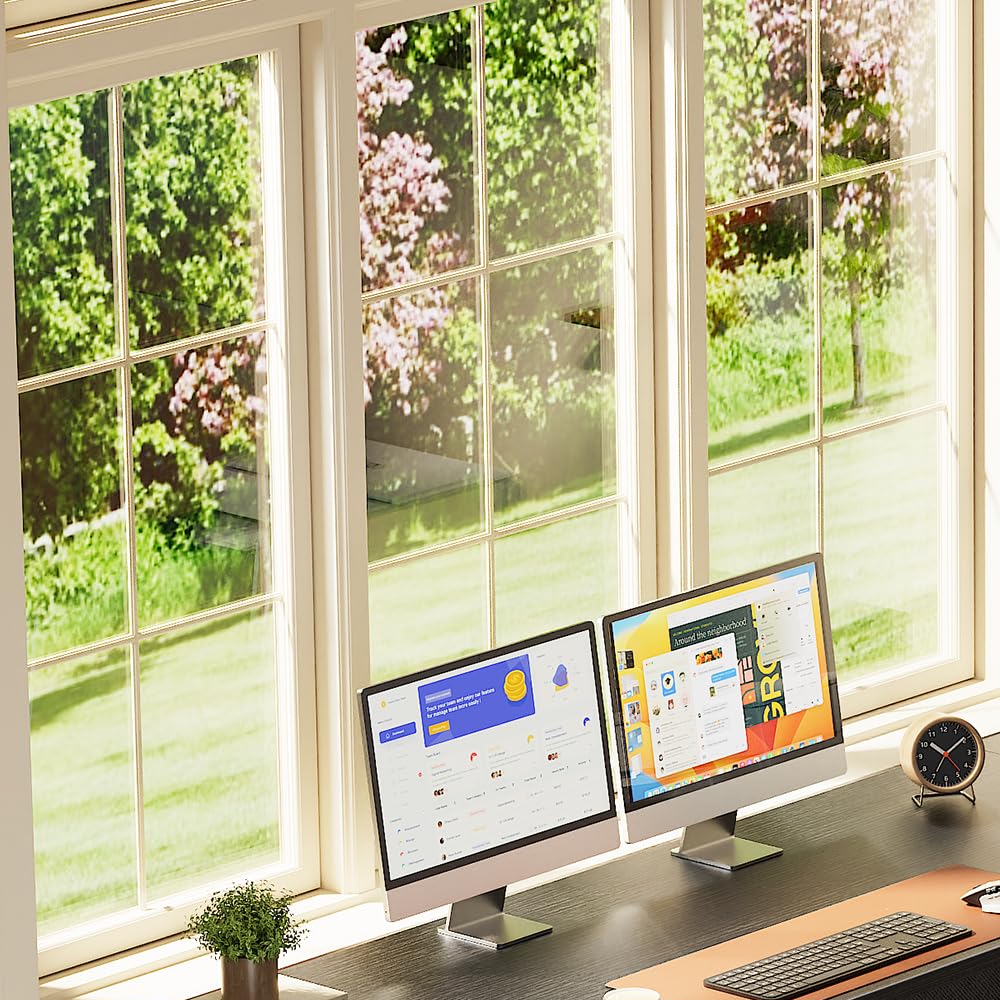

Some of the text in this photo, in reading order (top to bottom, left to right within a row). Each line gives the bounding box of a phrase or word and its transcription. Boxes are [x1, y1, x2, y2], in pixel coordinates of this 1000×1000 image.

[674, 632, 696, 647] Around
[696, 631, 707, 641] the
[707, 617, 747, 637] neighborhood
